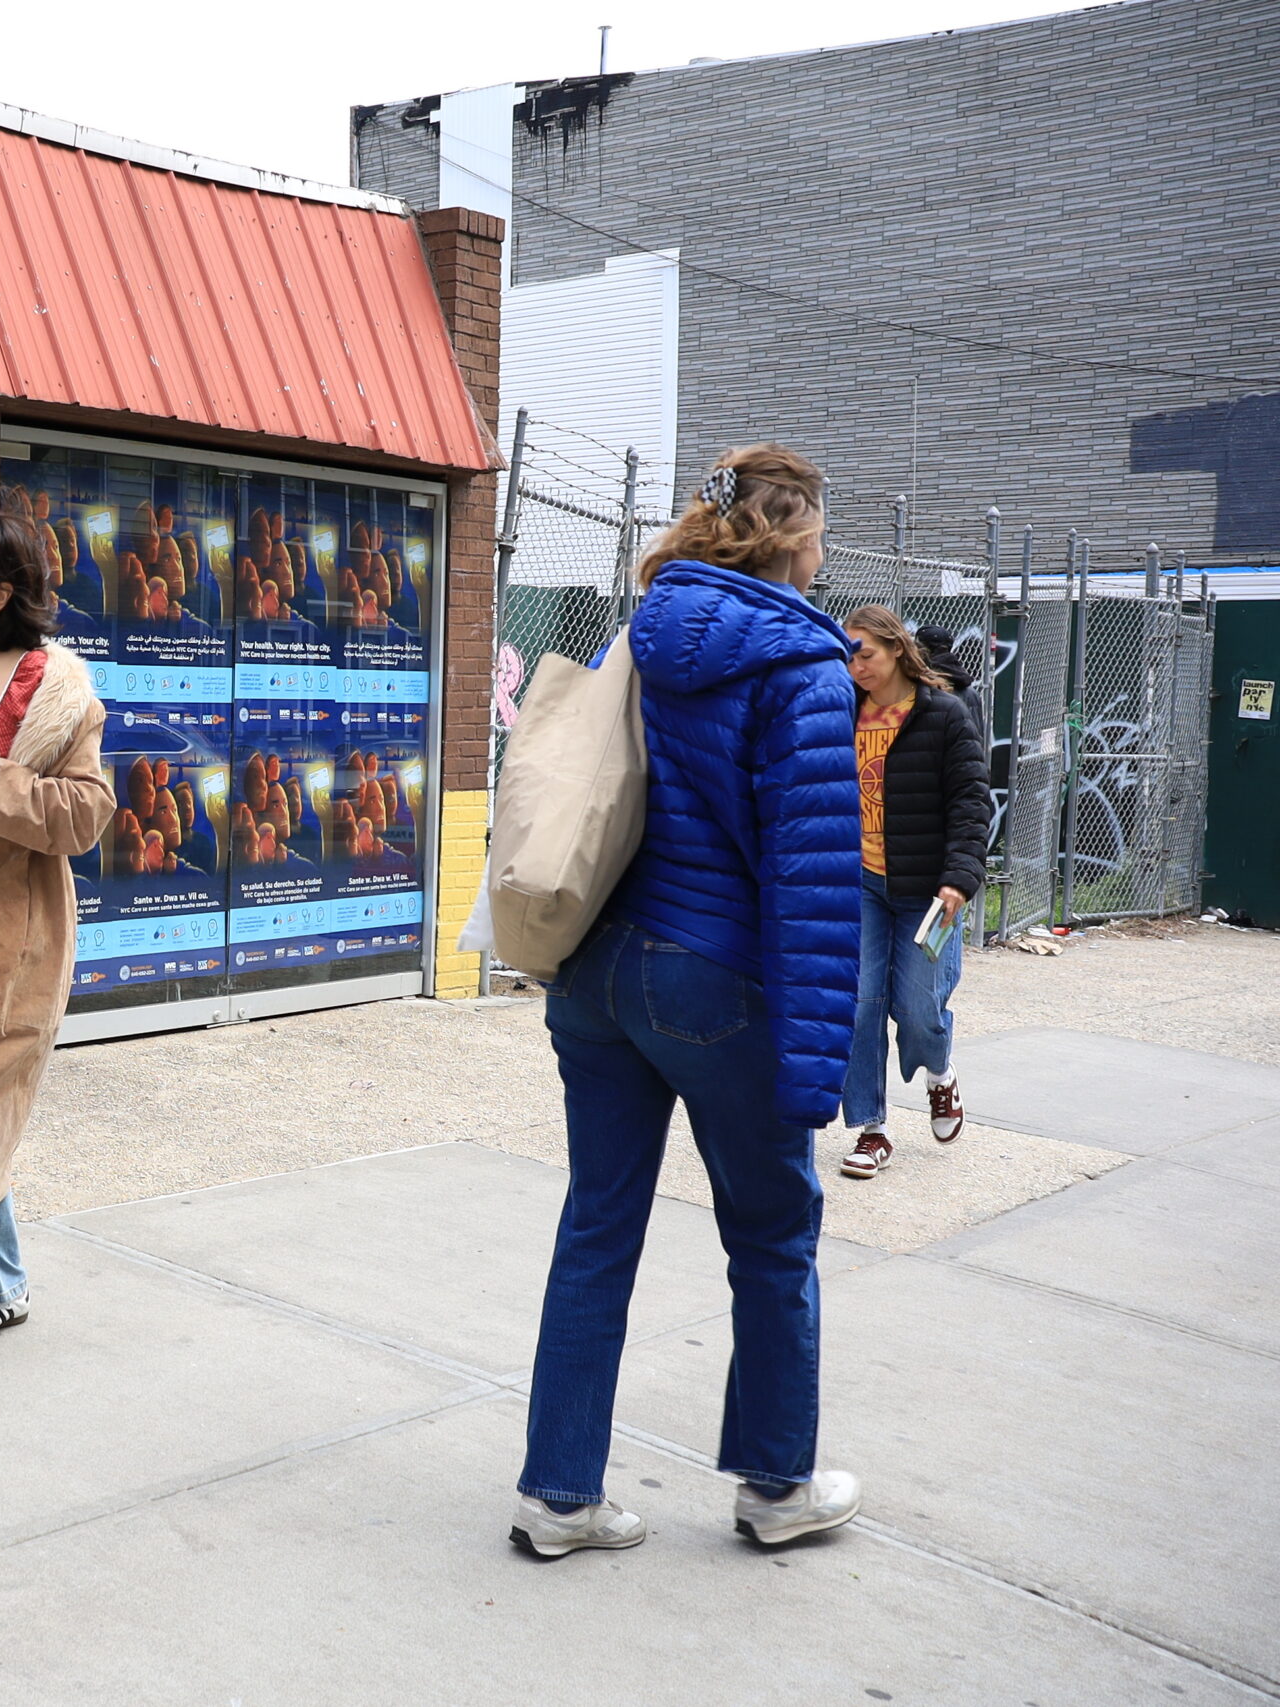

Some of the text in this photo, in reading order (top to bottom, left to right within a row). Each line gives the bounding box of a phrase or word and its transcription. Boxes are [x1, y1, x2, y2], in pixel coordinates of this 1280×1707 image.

[58, 635, 76, 646] right.
[78, 636, 94, 645] Your
[95, 636, 110, 647] city.
[241, 641, 254, 649] Your
[254, 641, 274, 650] health.
[275, 642, 288, 650] Your
[290, 642, 304, 652] right.
[320, 644, 330, 653] city.
